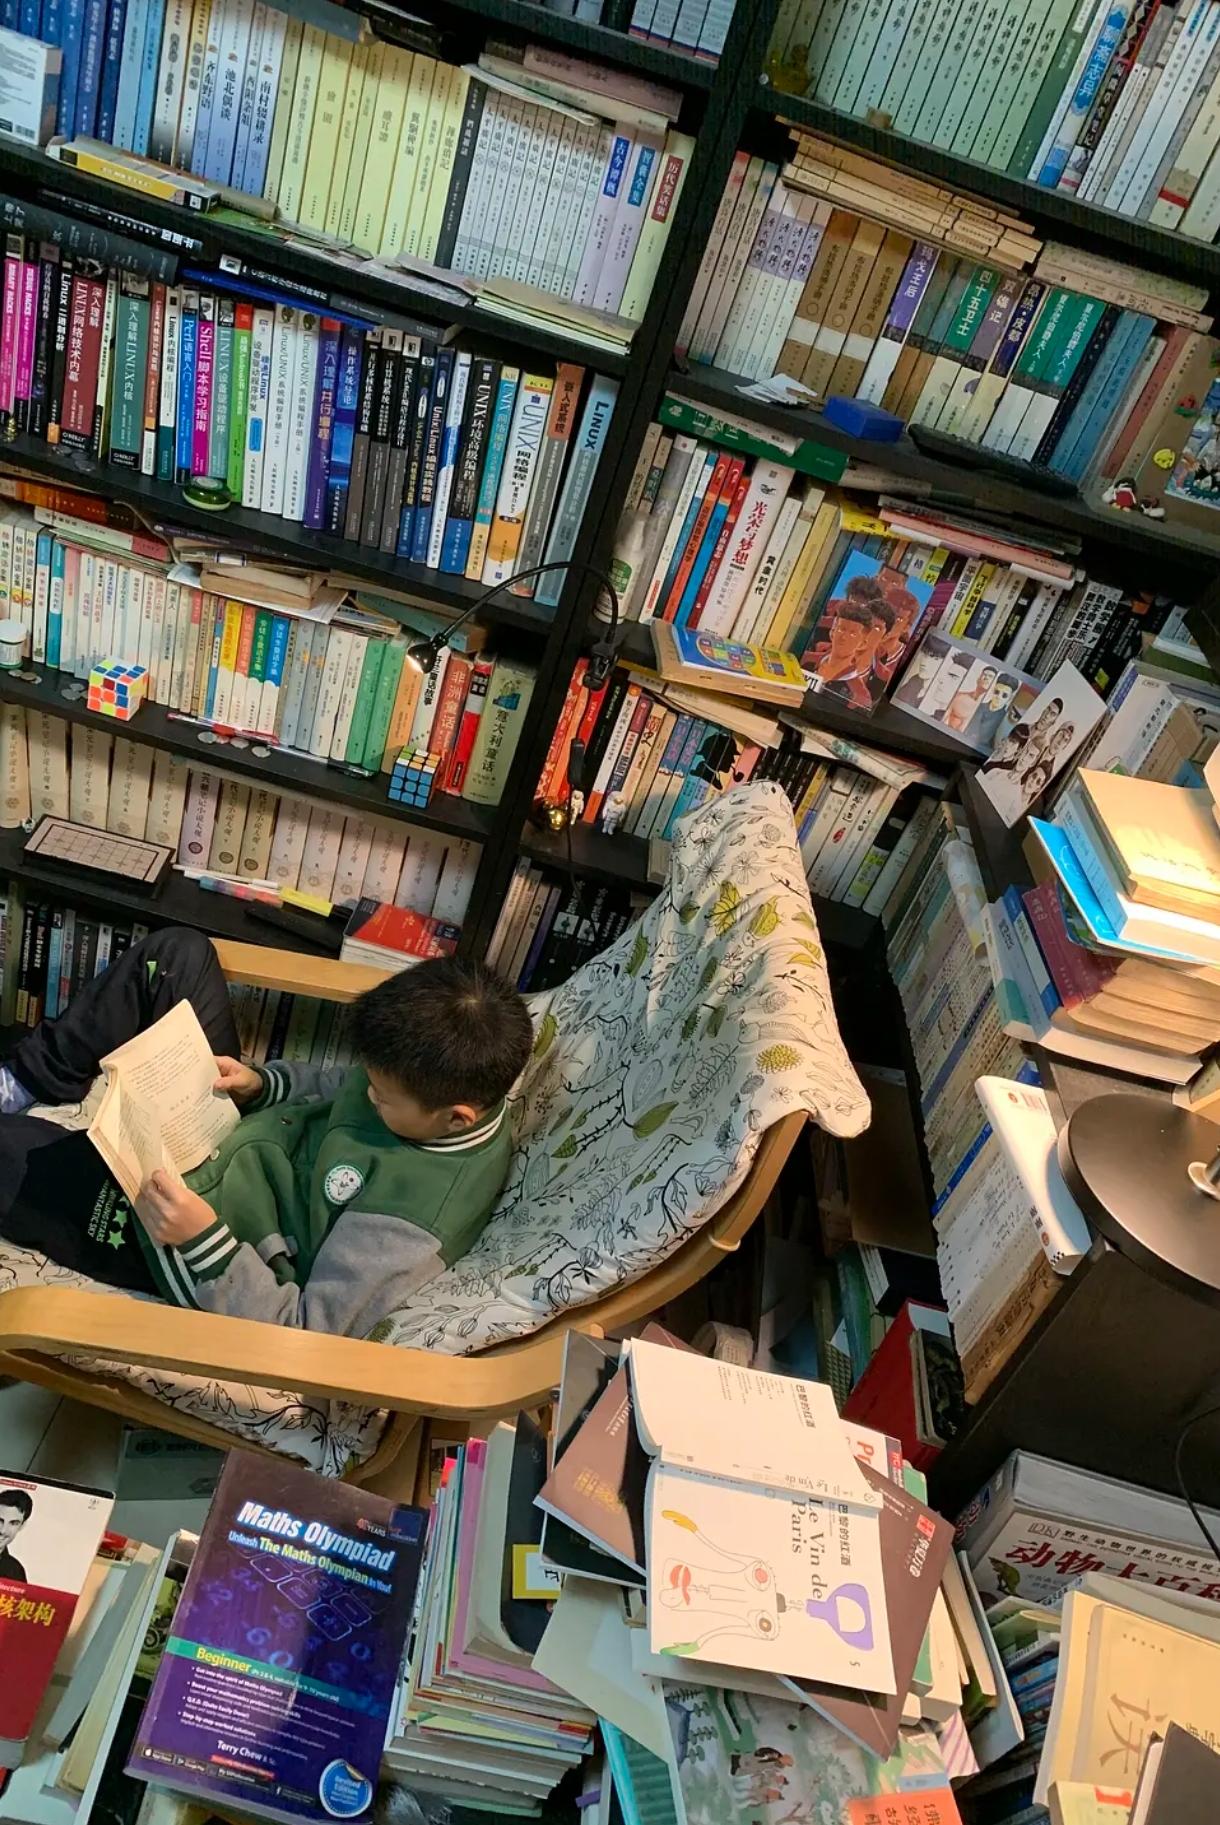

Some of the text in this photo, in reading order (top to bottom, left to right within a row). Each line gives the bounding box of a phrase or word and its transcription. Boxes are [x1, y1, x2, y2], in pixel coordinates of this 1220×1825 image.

[220, 67, 237, 121] 池北偶谈
[955, 269, 993, 337] 四十五卫士
[988, 278, 1020, 324] 双雄记
[463, 384, 492, 481] UNIX环境高级编程
[585, 400, 609, 450] LINUX
[731, 501, 769, 566] 光荣与梦想
[754, 555, 776, 596] 黄金时代
[442, 672, 466, 731] 非洲童话
[482, 710, 507, 771] 意大利童话
[795, 1384, 817, 1428] 巴黎的红酒
[237, 1501, 396, 1571] Maths Olympiad
[790, 1500, 808, 1555] Paris
[808, 1497, 829, 1600] Le Vin de
[837, 1502, 852, 1567] 巴黎的红酒
[1027, 1521, 1062, 1539] DK
[228, 1530, 258, 1548] Unleash
[258, 1536, 281, 1554] The
[281, 1543, 317, 1566] Maths
[318, 1556, 369, 1585] Olympian
[196, 1647, 252, 1673] Beginner
[215, 1739, 239, 1755] Terry
[238, 1746, 263, 1761] Chew
